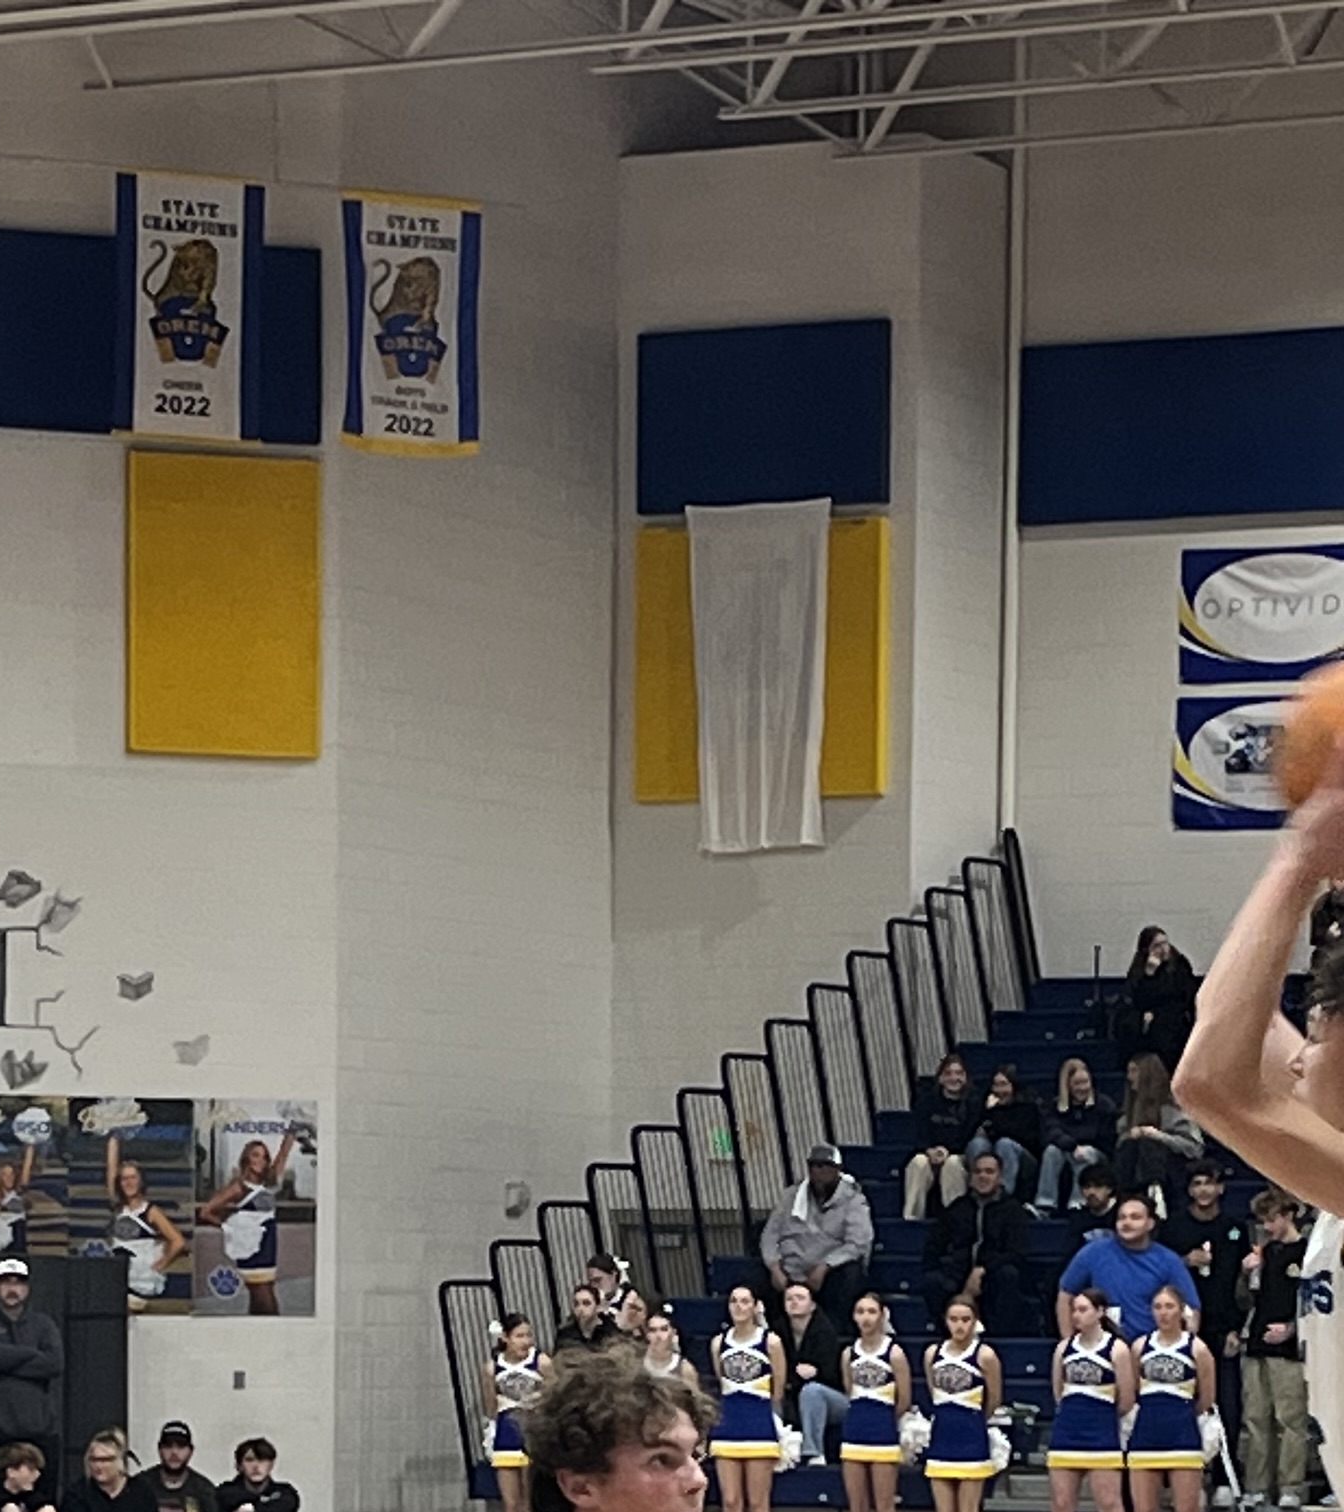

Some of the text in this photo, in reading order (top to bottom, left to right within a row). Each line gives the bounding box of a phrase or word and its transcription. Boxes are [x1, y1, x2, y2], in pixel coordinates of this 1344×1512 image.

[162, 199, 219, 219] STATE
[142, 214, 238, 238] CHAMPIONS
[386, 214, 440, 233] STATE
[366, 231, 457, 253] CHAMPIONS
[157, 319, 220, 341] OREM
[155, 393, 212, 417] 2022
[383, 413, 436, 437] 2022
